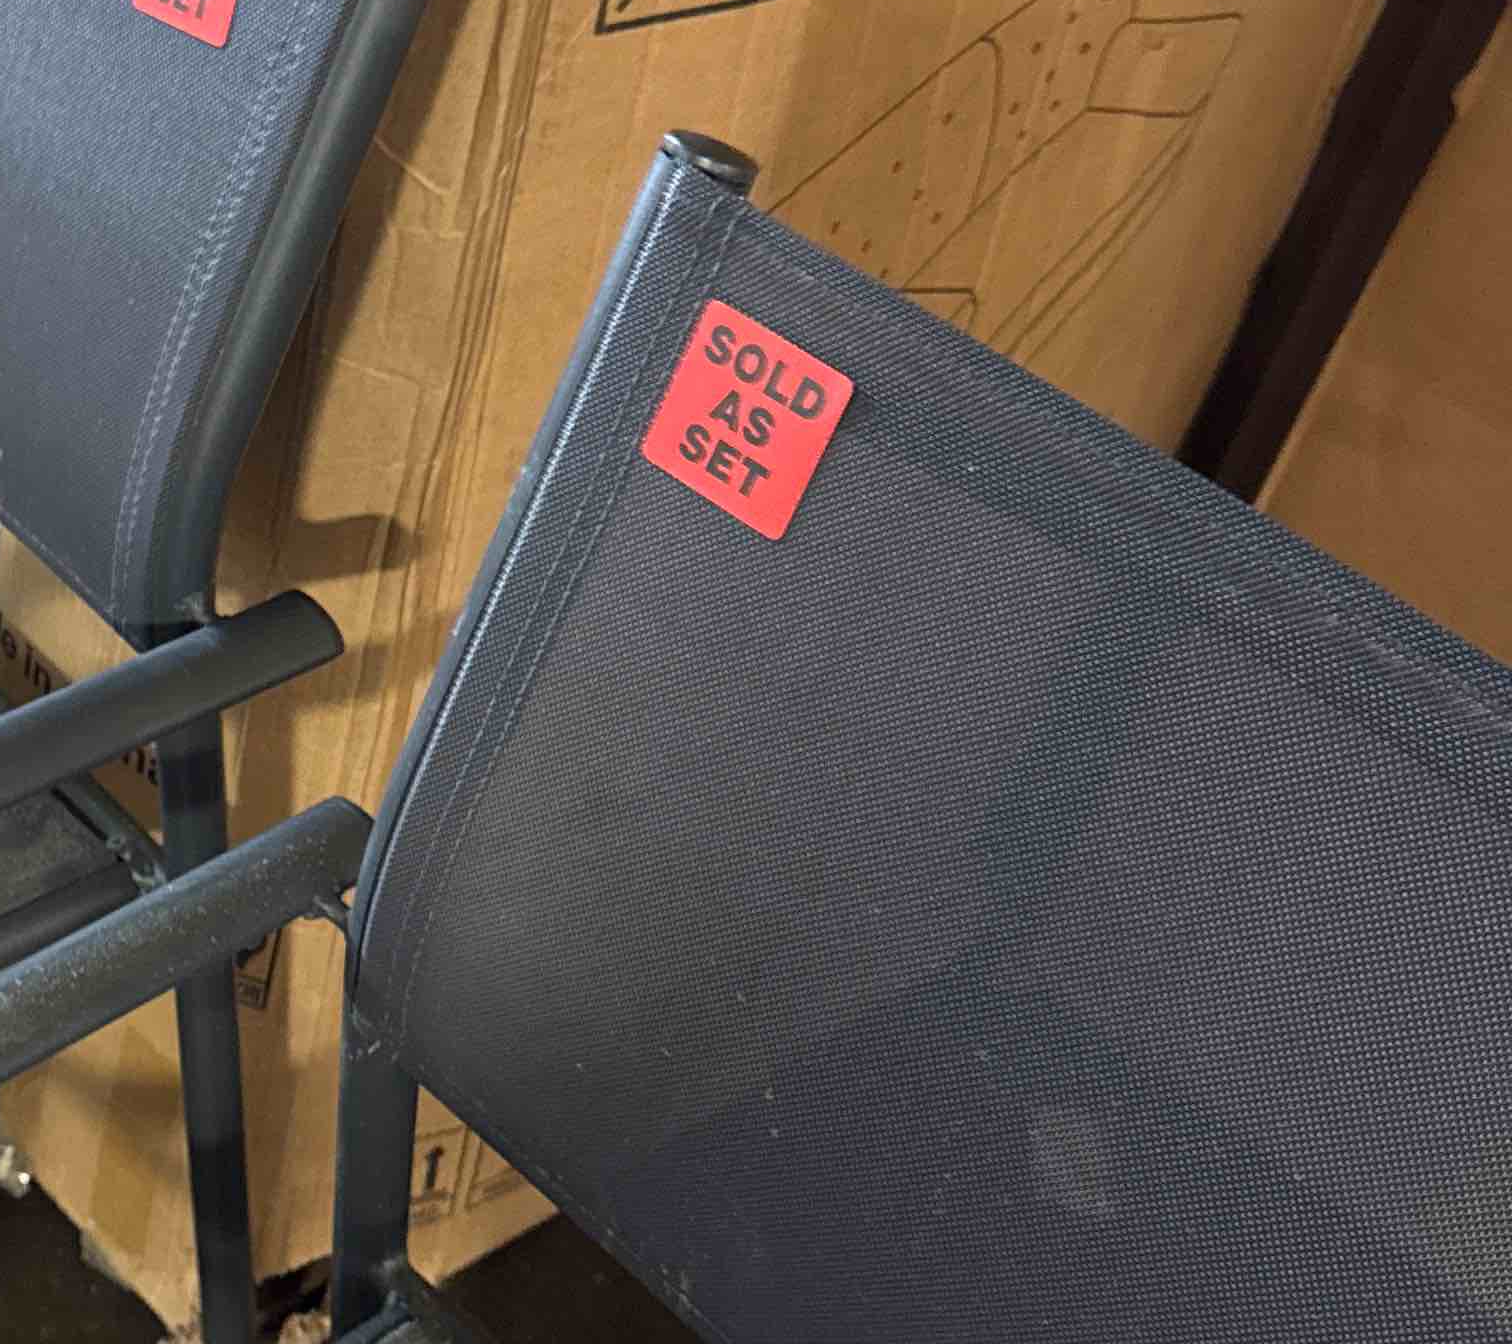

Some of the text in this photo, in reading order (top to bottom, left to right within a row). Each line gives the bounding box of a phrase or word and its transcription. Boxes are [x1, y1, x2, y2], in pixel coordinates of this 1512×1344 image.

[703, 325, 827, 420] SOLD
[709, 389, 776, 448] AS
[678, 423, 772, 498] SET
